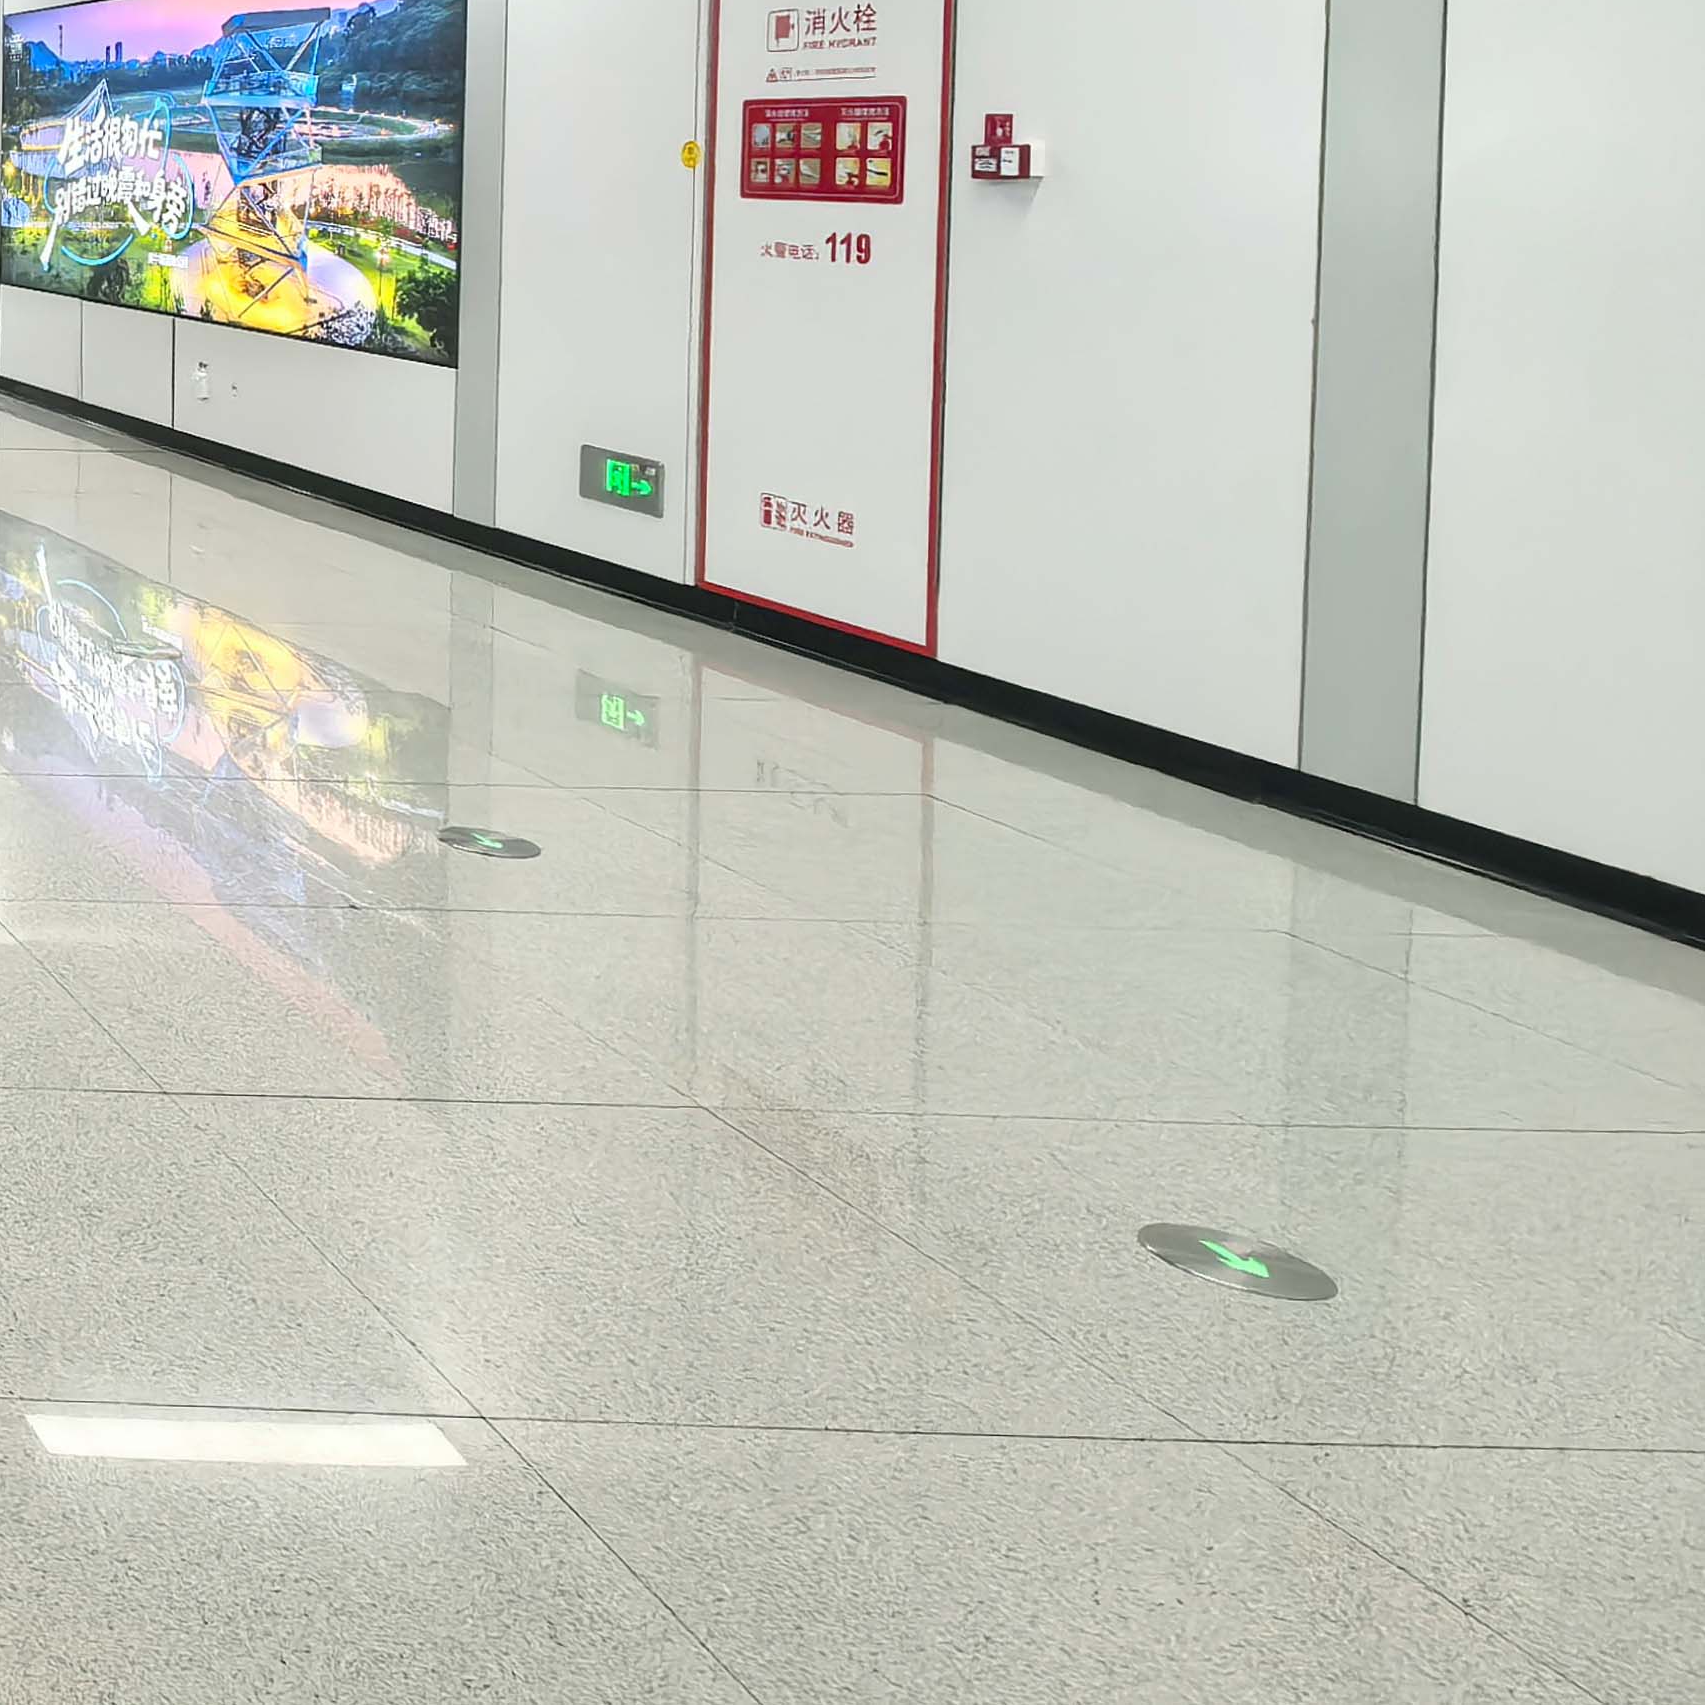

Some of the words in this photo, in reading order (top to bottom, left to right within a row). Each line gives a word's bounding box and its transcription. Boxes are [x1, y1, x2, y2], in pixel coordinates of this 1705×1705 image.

[804, 2, 877, 35] 消火栓
[825, 232, 872, 265] 119
[791, 500, 854, 535] 灭火器
